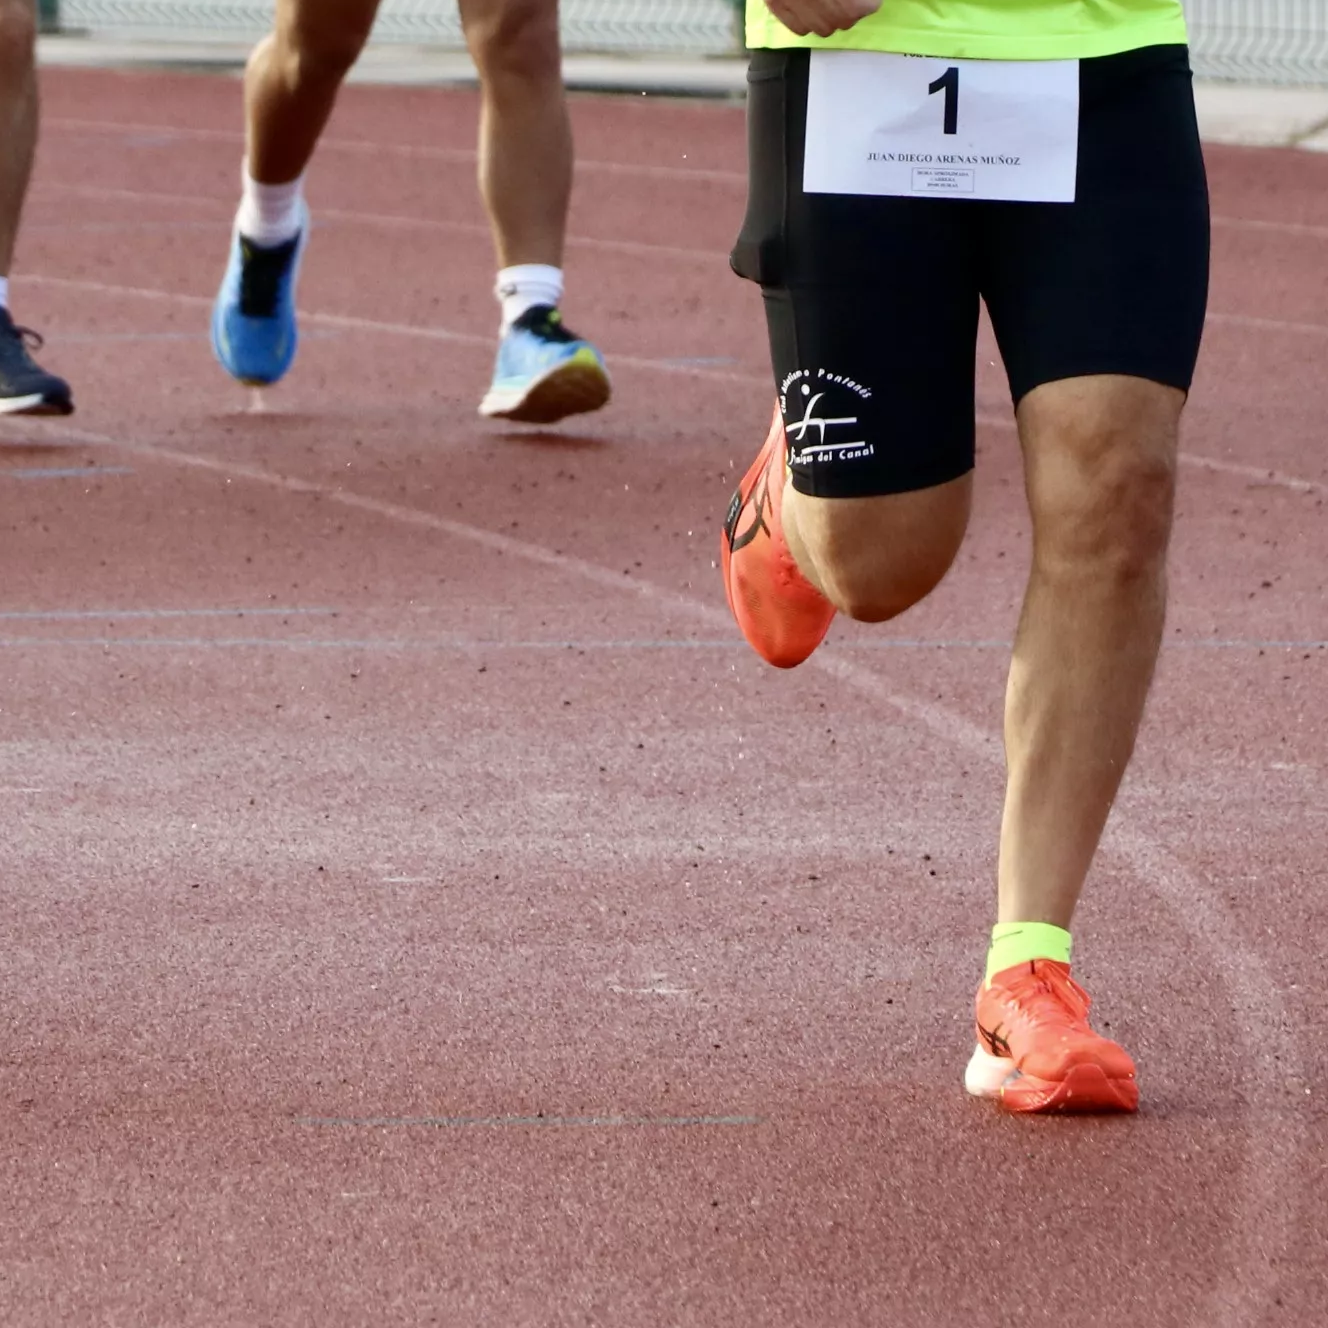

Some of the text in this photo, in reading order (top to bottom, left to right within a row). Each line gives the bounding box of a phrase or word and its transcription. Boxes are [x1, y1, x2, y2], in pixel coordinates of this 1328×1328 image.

[928, 66, 960, 135] 1
[867, 152, 1021, 166] JUAN DIEGO ARENAS MUÑOZ
[817, 368, 872, 398] Pontanés
[818, 450, 833, 462] del
[839, 444, 875, 460] Canal
